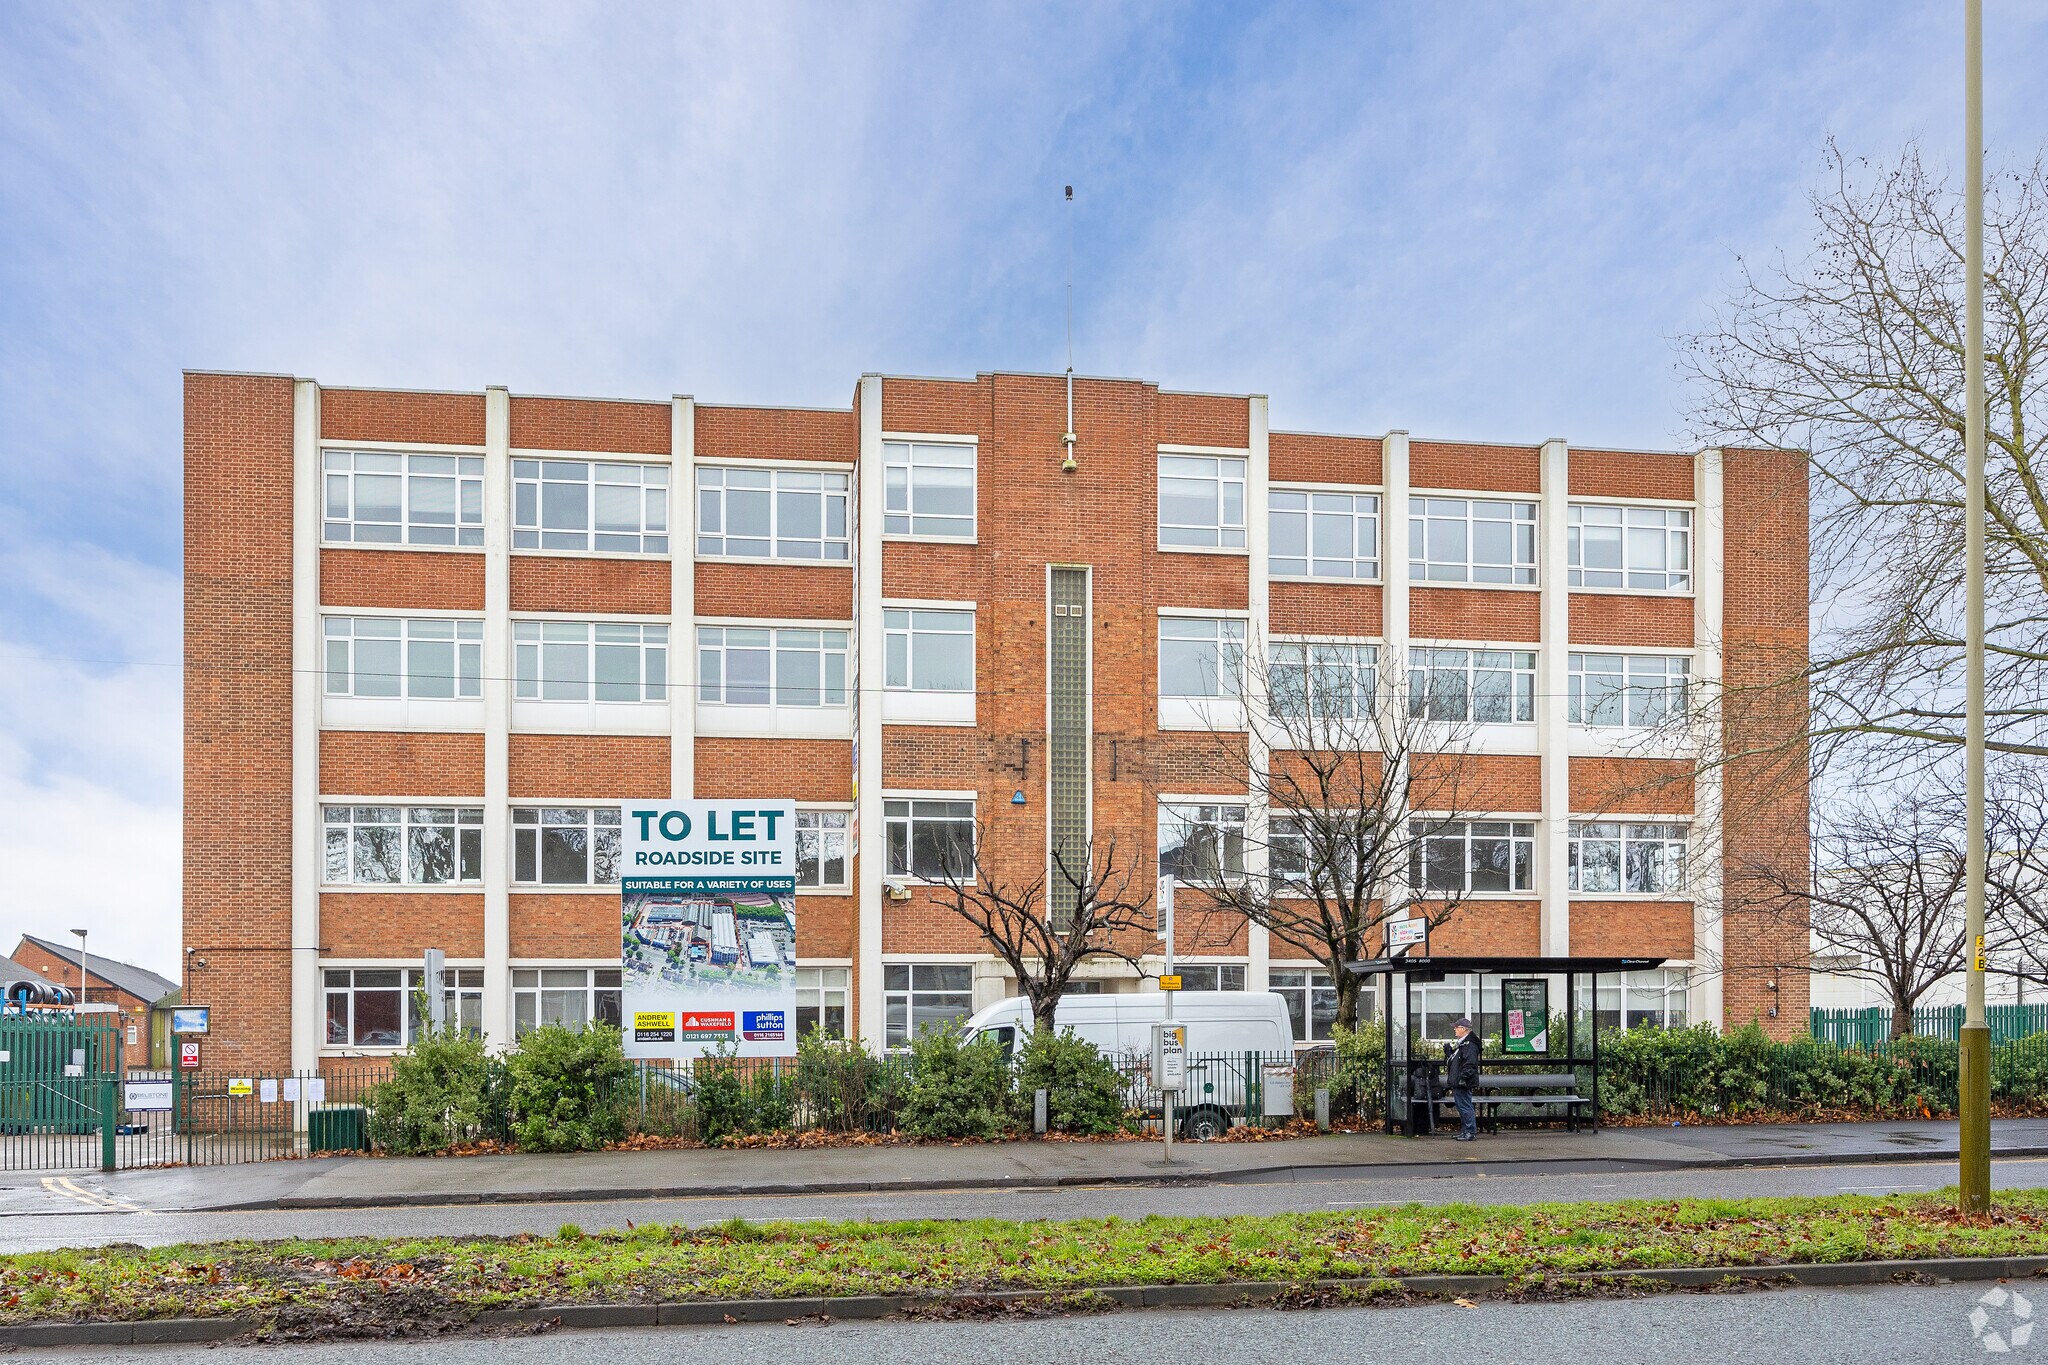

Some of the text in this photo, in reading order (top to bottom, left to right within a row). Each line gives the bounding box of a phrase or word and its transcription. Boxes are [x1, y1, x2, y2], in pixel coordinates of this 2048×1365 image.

[631, 810, 785, 842] TO LET
[635, 850, 782, 866] ROADSIDE SITE
[625, 880, 792, 890] SUITABLE FOR A VARIETY OF USES
[756, 1013, 783, 1024] phillips
[756, 1020, 783, 1029] sutton
[1163, 1031, 1177, 1040] big
[1163, 1047, 1182, 1056] plan
